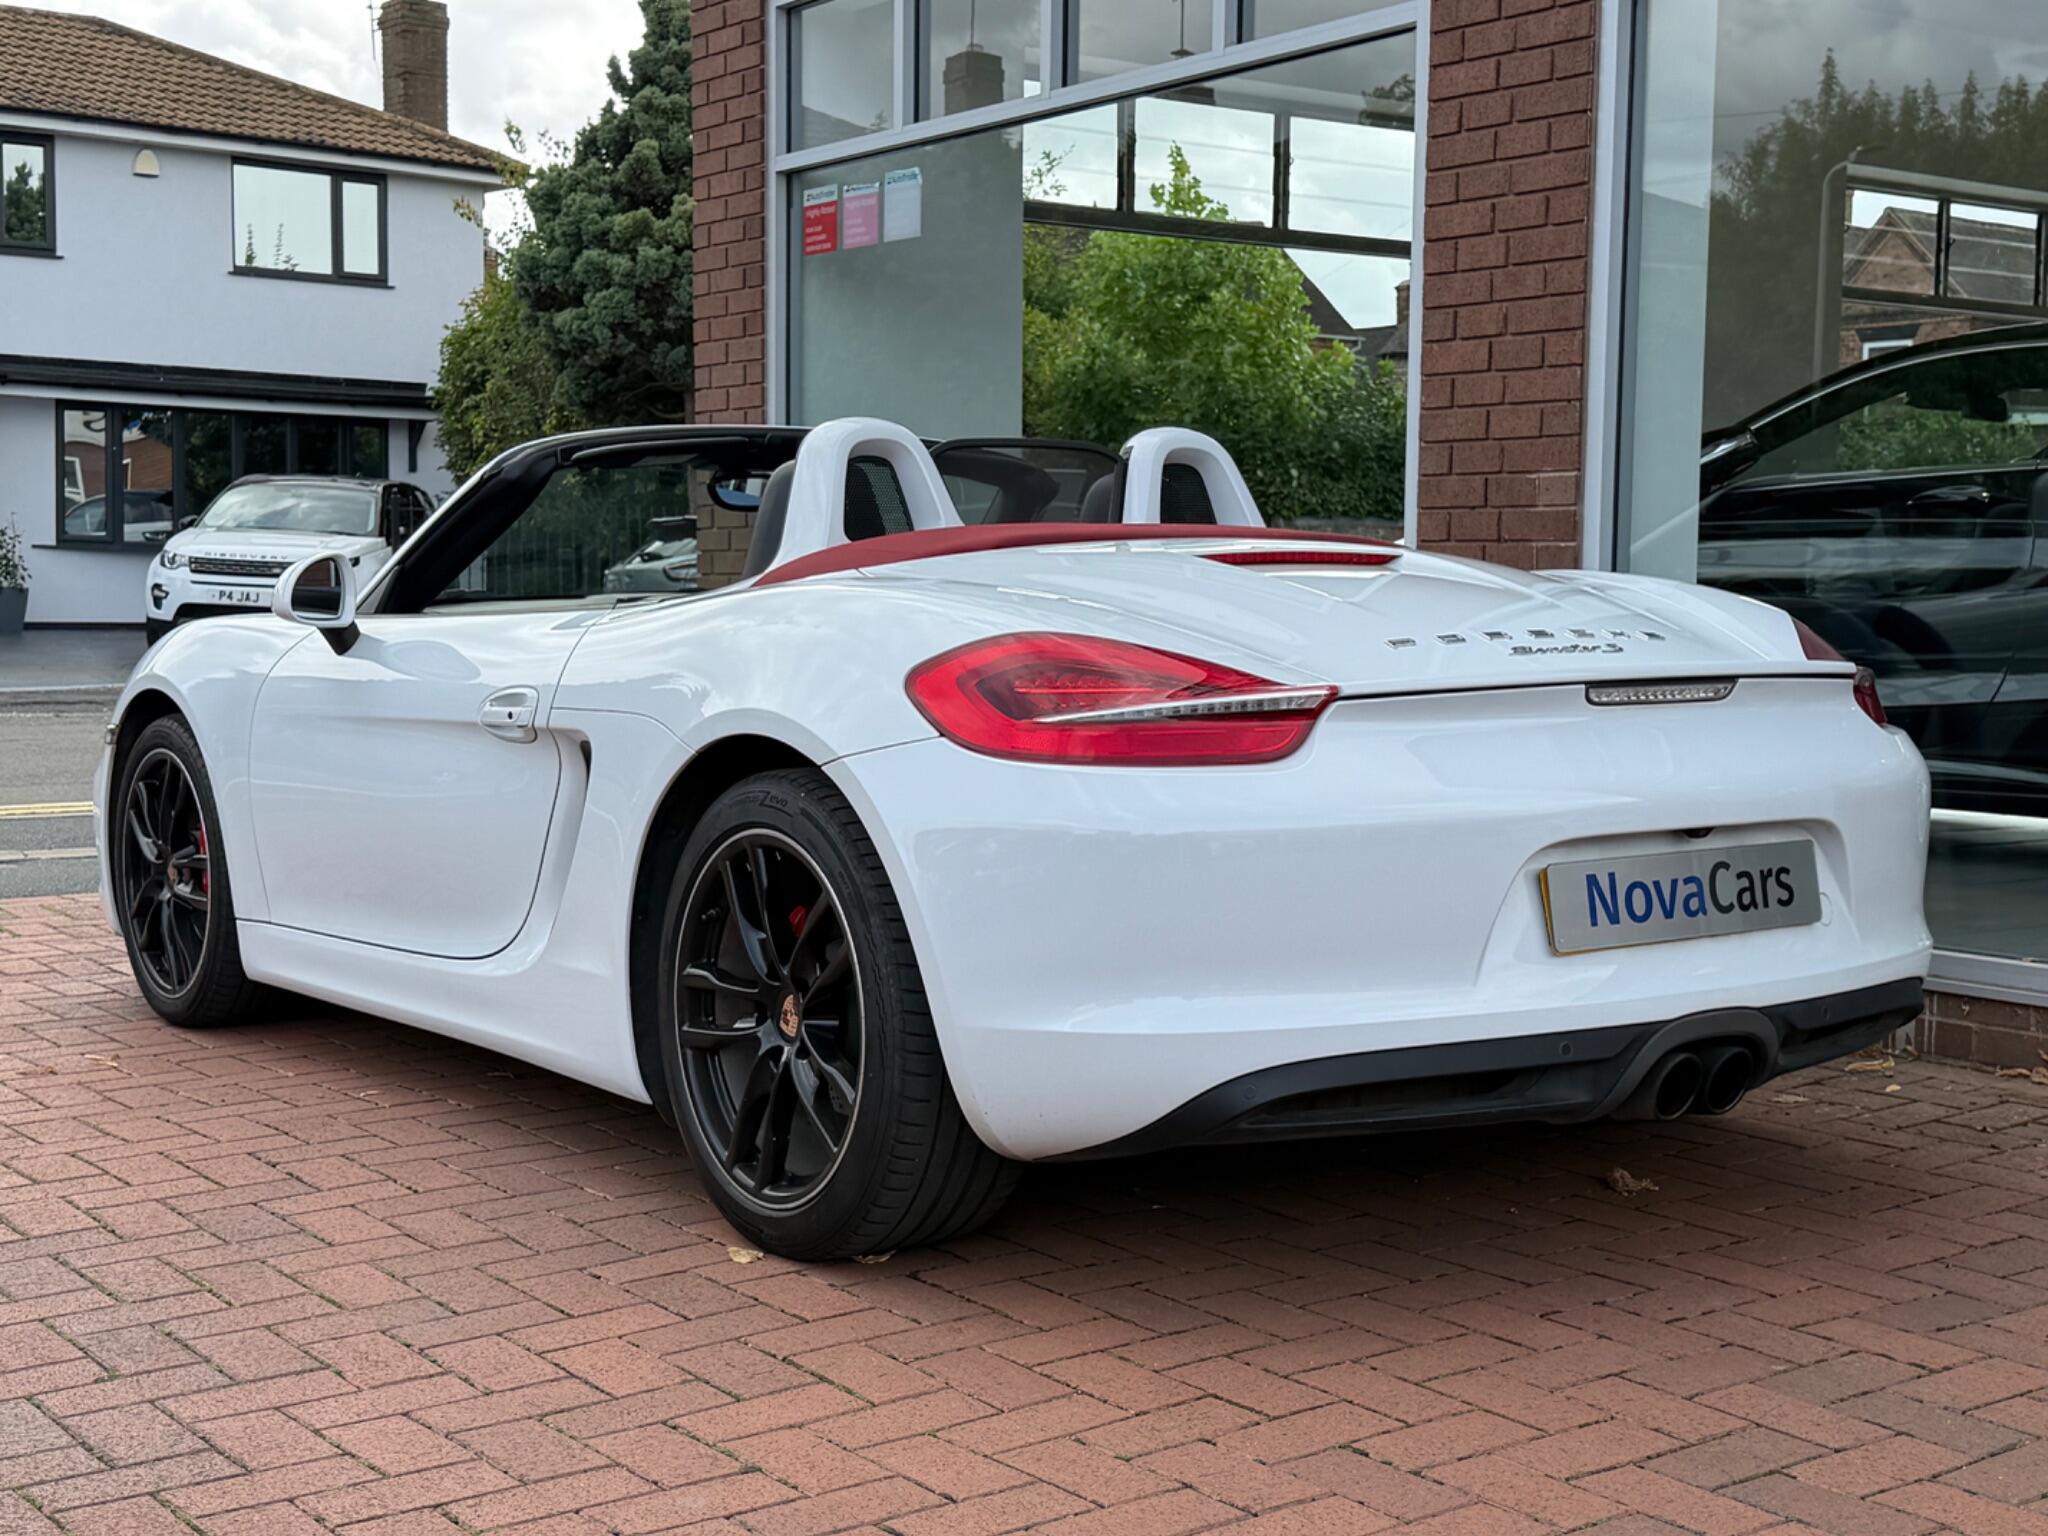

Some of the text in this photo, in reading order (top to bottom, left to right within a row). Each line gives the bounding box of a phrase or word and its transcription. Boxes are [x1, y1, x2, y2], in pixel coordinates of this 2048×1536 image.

[218, 589, 260, 603] P4 JAJ
[1585, 860, 1795, 928] NovaCars
